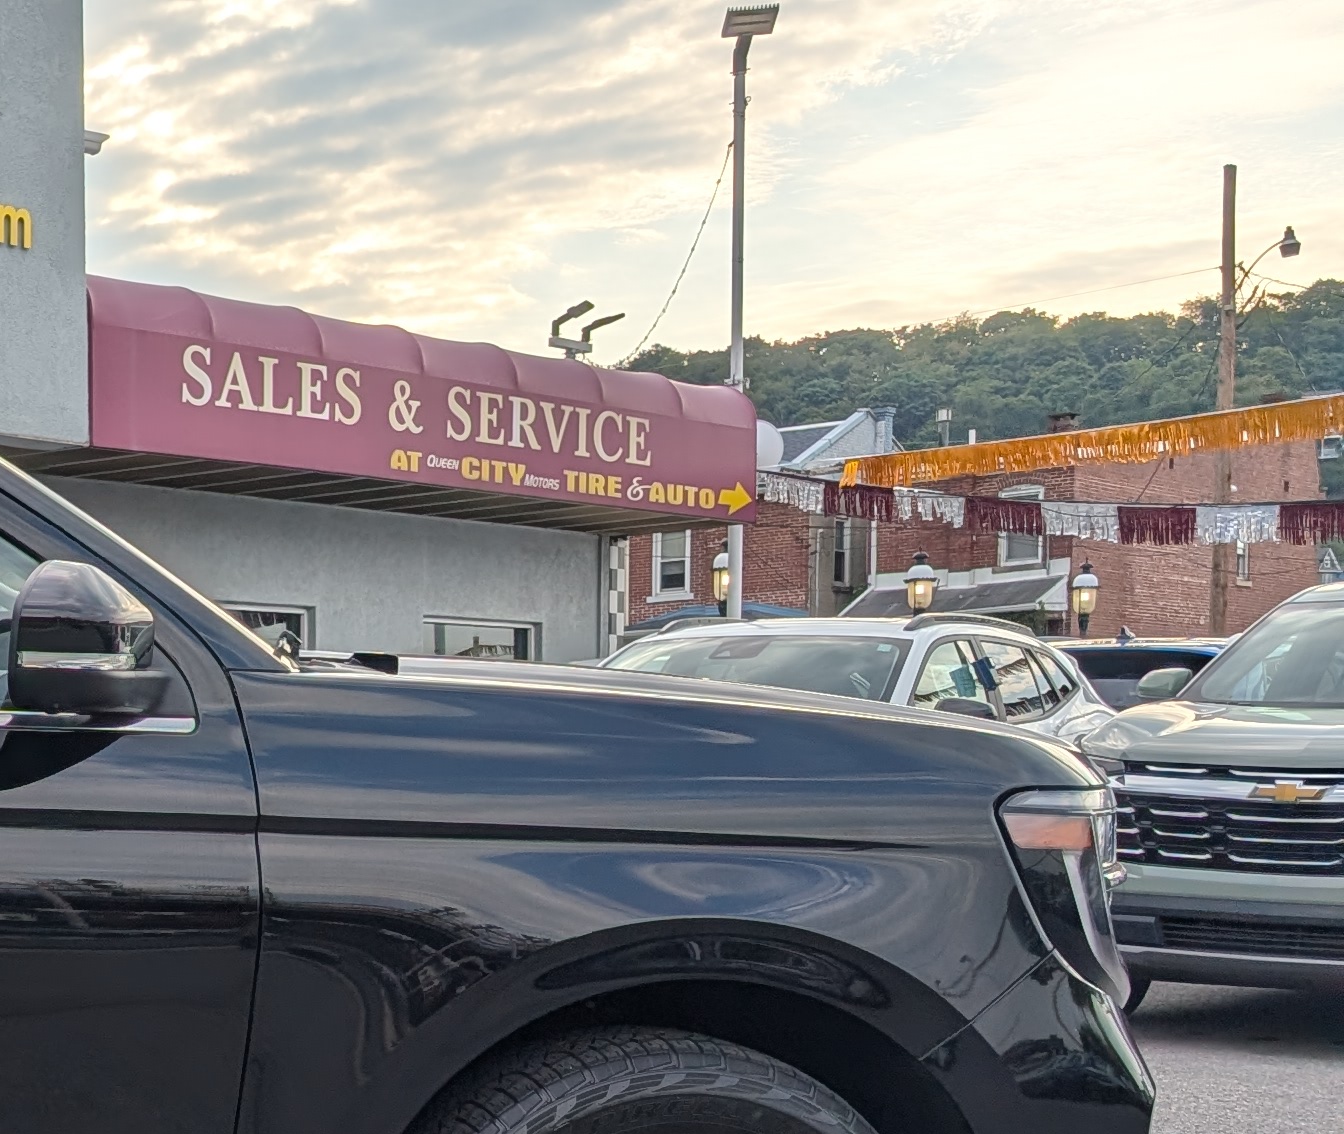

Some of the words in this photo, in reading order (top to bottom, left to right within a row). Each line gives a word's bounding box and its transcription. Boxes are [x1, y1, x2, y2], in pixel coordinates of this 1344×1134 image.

[181, 344, 362, 426] SALES
[388, 379, 423, 434] &
[446, 385, 652, 467] SERVICE
[390, 449, 422, 473] AT
[426, 453, 460, 472] QUEEN
[461, 455, 526, 487] CITY
[524, 473, 560, 491] MOTORS
[563, 469, 622, 499] TIRE
[626, 476, 653, 501] &
[649, 482, 716, 510] AUTO
